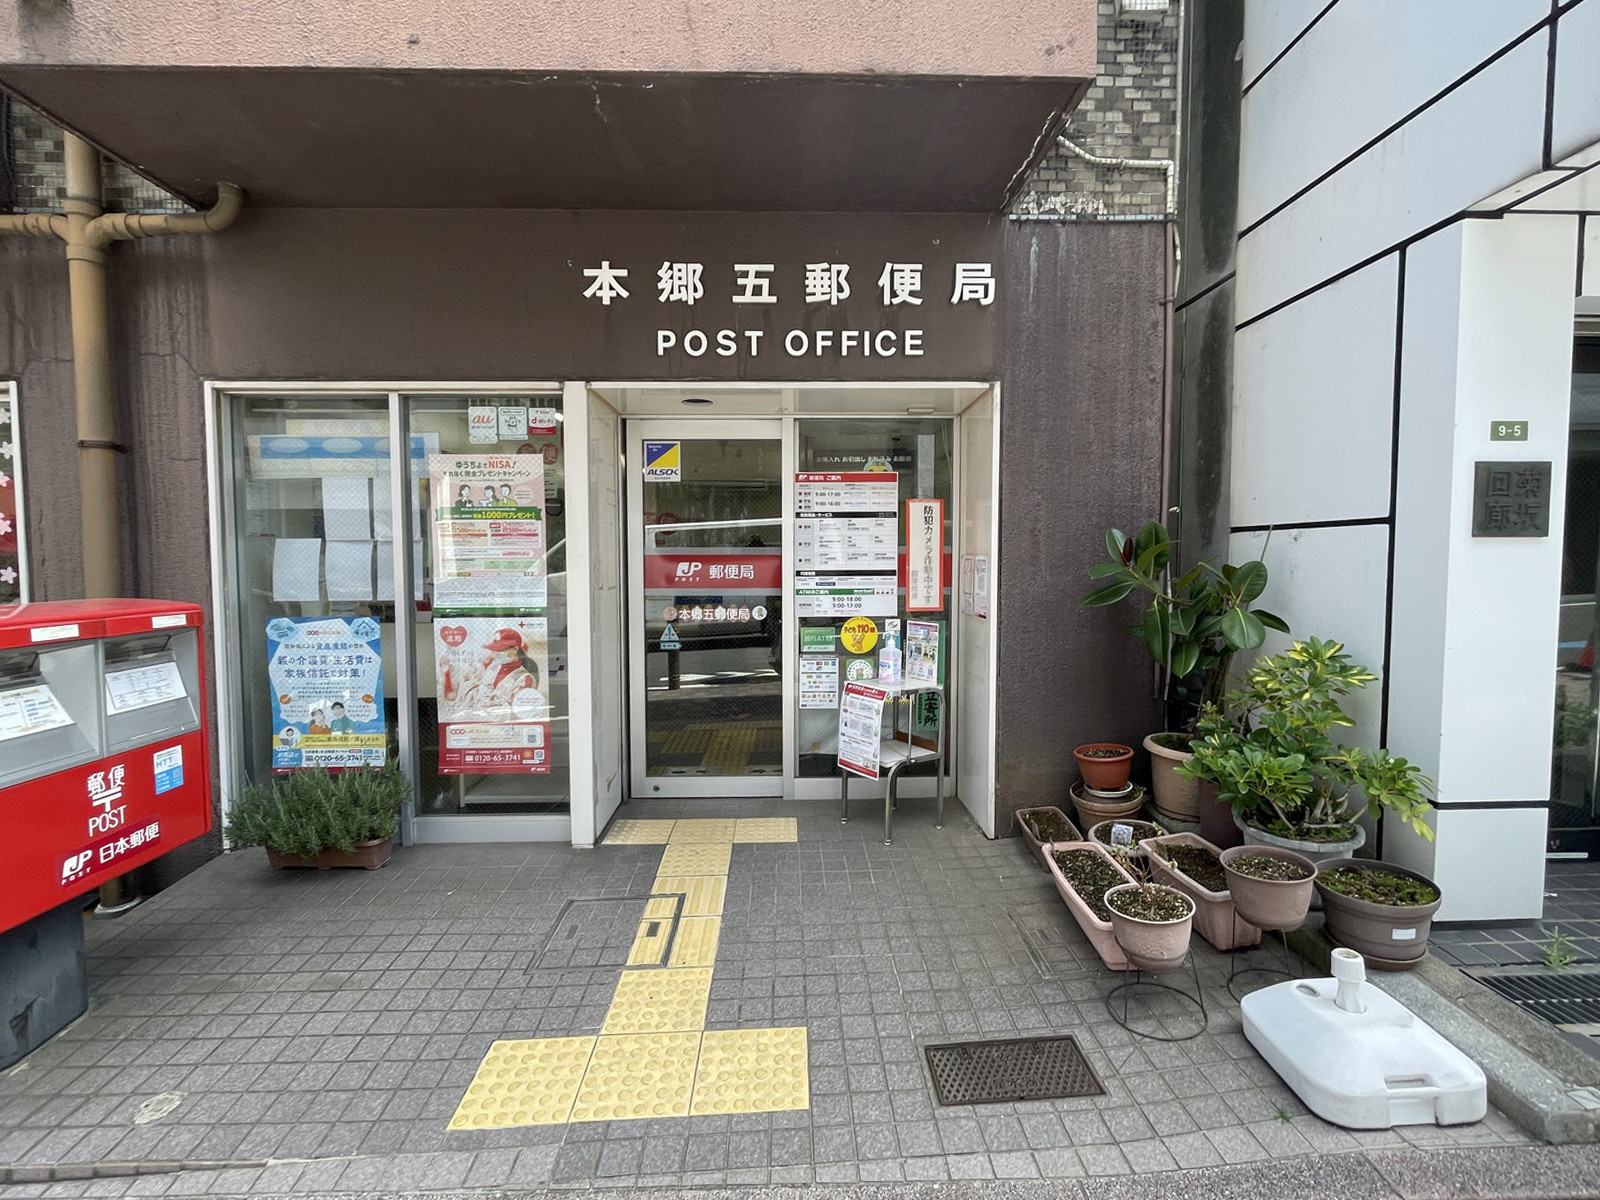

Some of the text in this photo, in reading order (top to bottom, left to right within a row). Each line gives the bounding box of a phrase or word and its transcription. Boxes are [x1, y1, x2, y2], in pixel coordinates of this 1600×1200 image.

[583, 261, 996, 306] 本郷五郵便局
[657, 329, 925, 357] POST OFFICE
[1498, 425, 1522, 436] 9-5
[709, 564, 754, 579] 郵便局
[87, 764, 126, 797] 郵便
[88, 805, 127, 837] POST
[98, 822, 160, 864] 日本郵便
